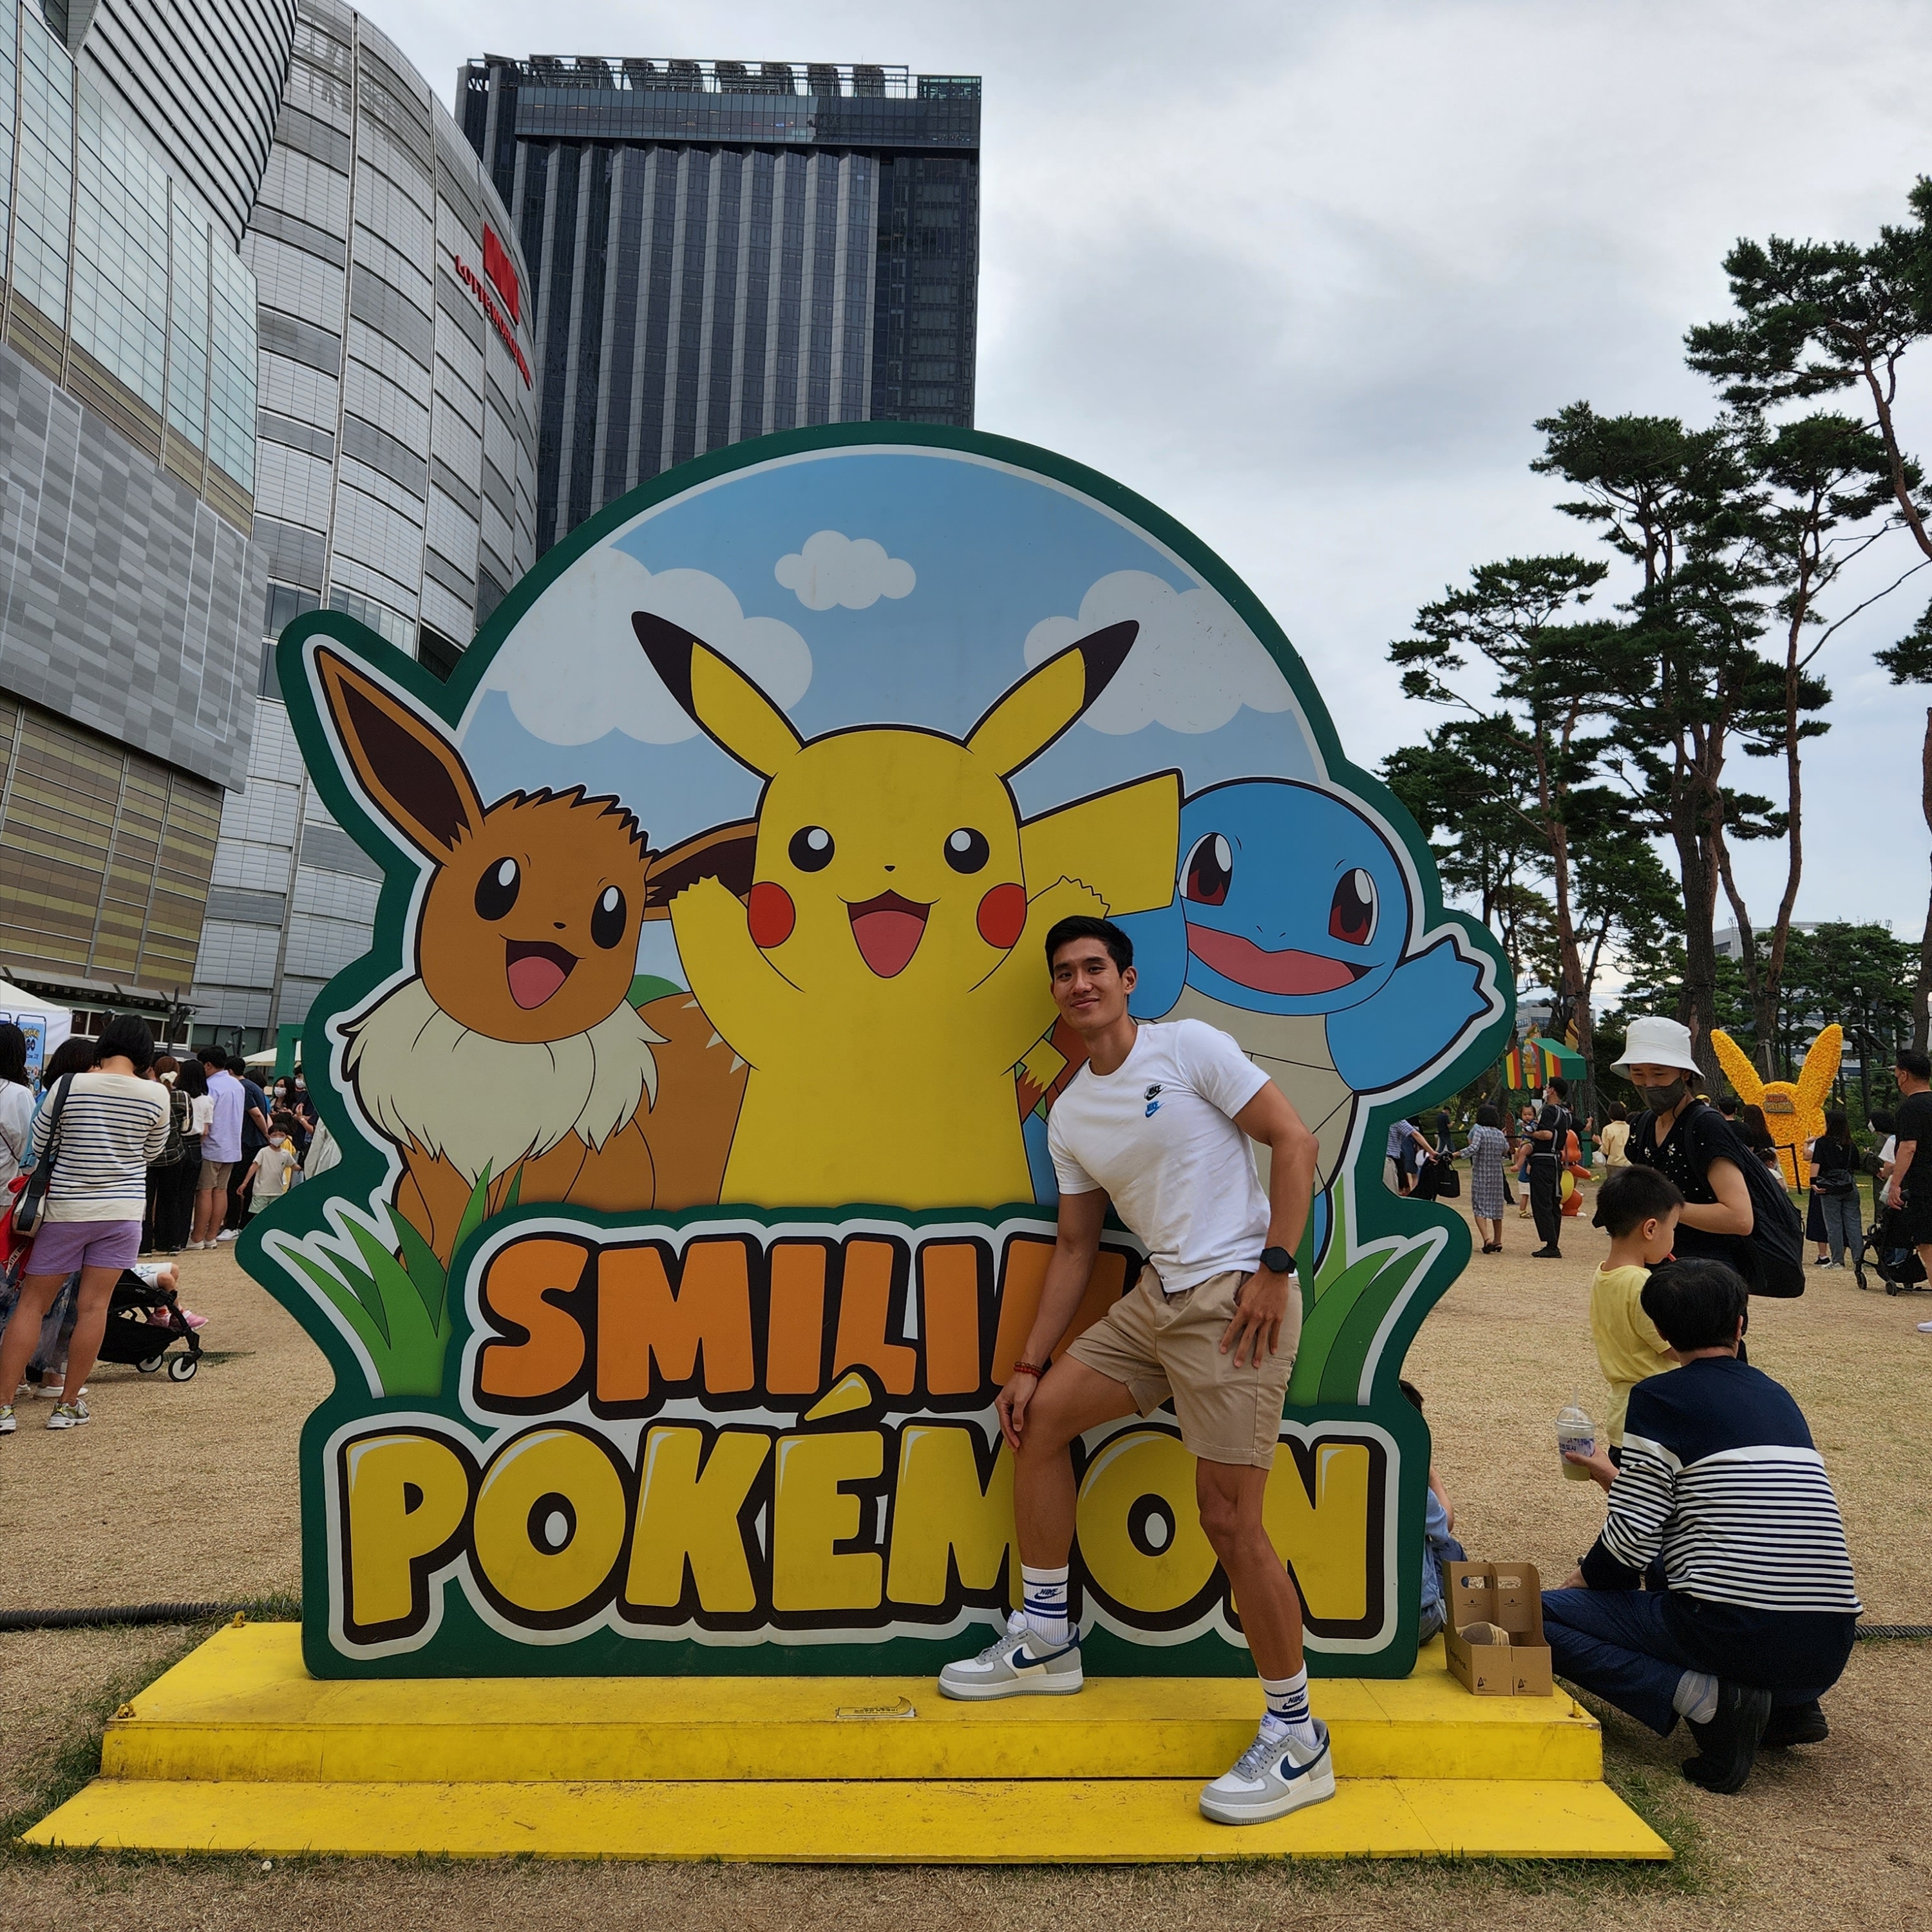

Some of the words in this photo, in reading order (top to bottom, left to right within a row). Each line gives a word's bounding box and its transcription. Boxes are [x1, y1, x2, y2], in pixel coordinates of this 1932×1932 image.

[455, 255, 491, 314] LOTTE
[1149, 1084, 1161, 1095] NIKE
[1146, 1101, 1159, 1112] NIKE
[1288, 1692, 1304, 1703] NIKE
